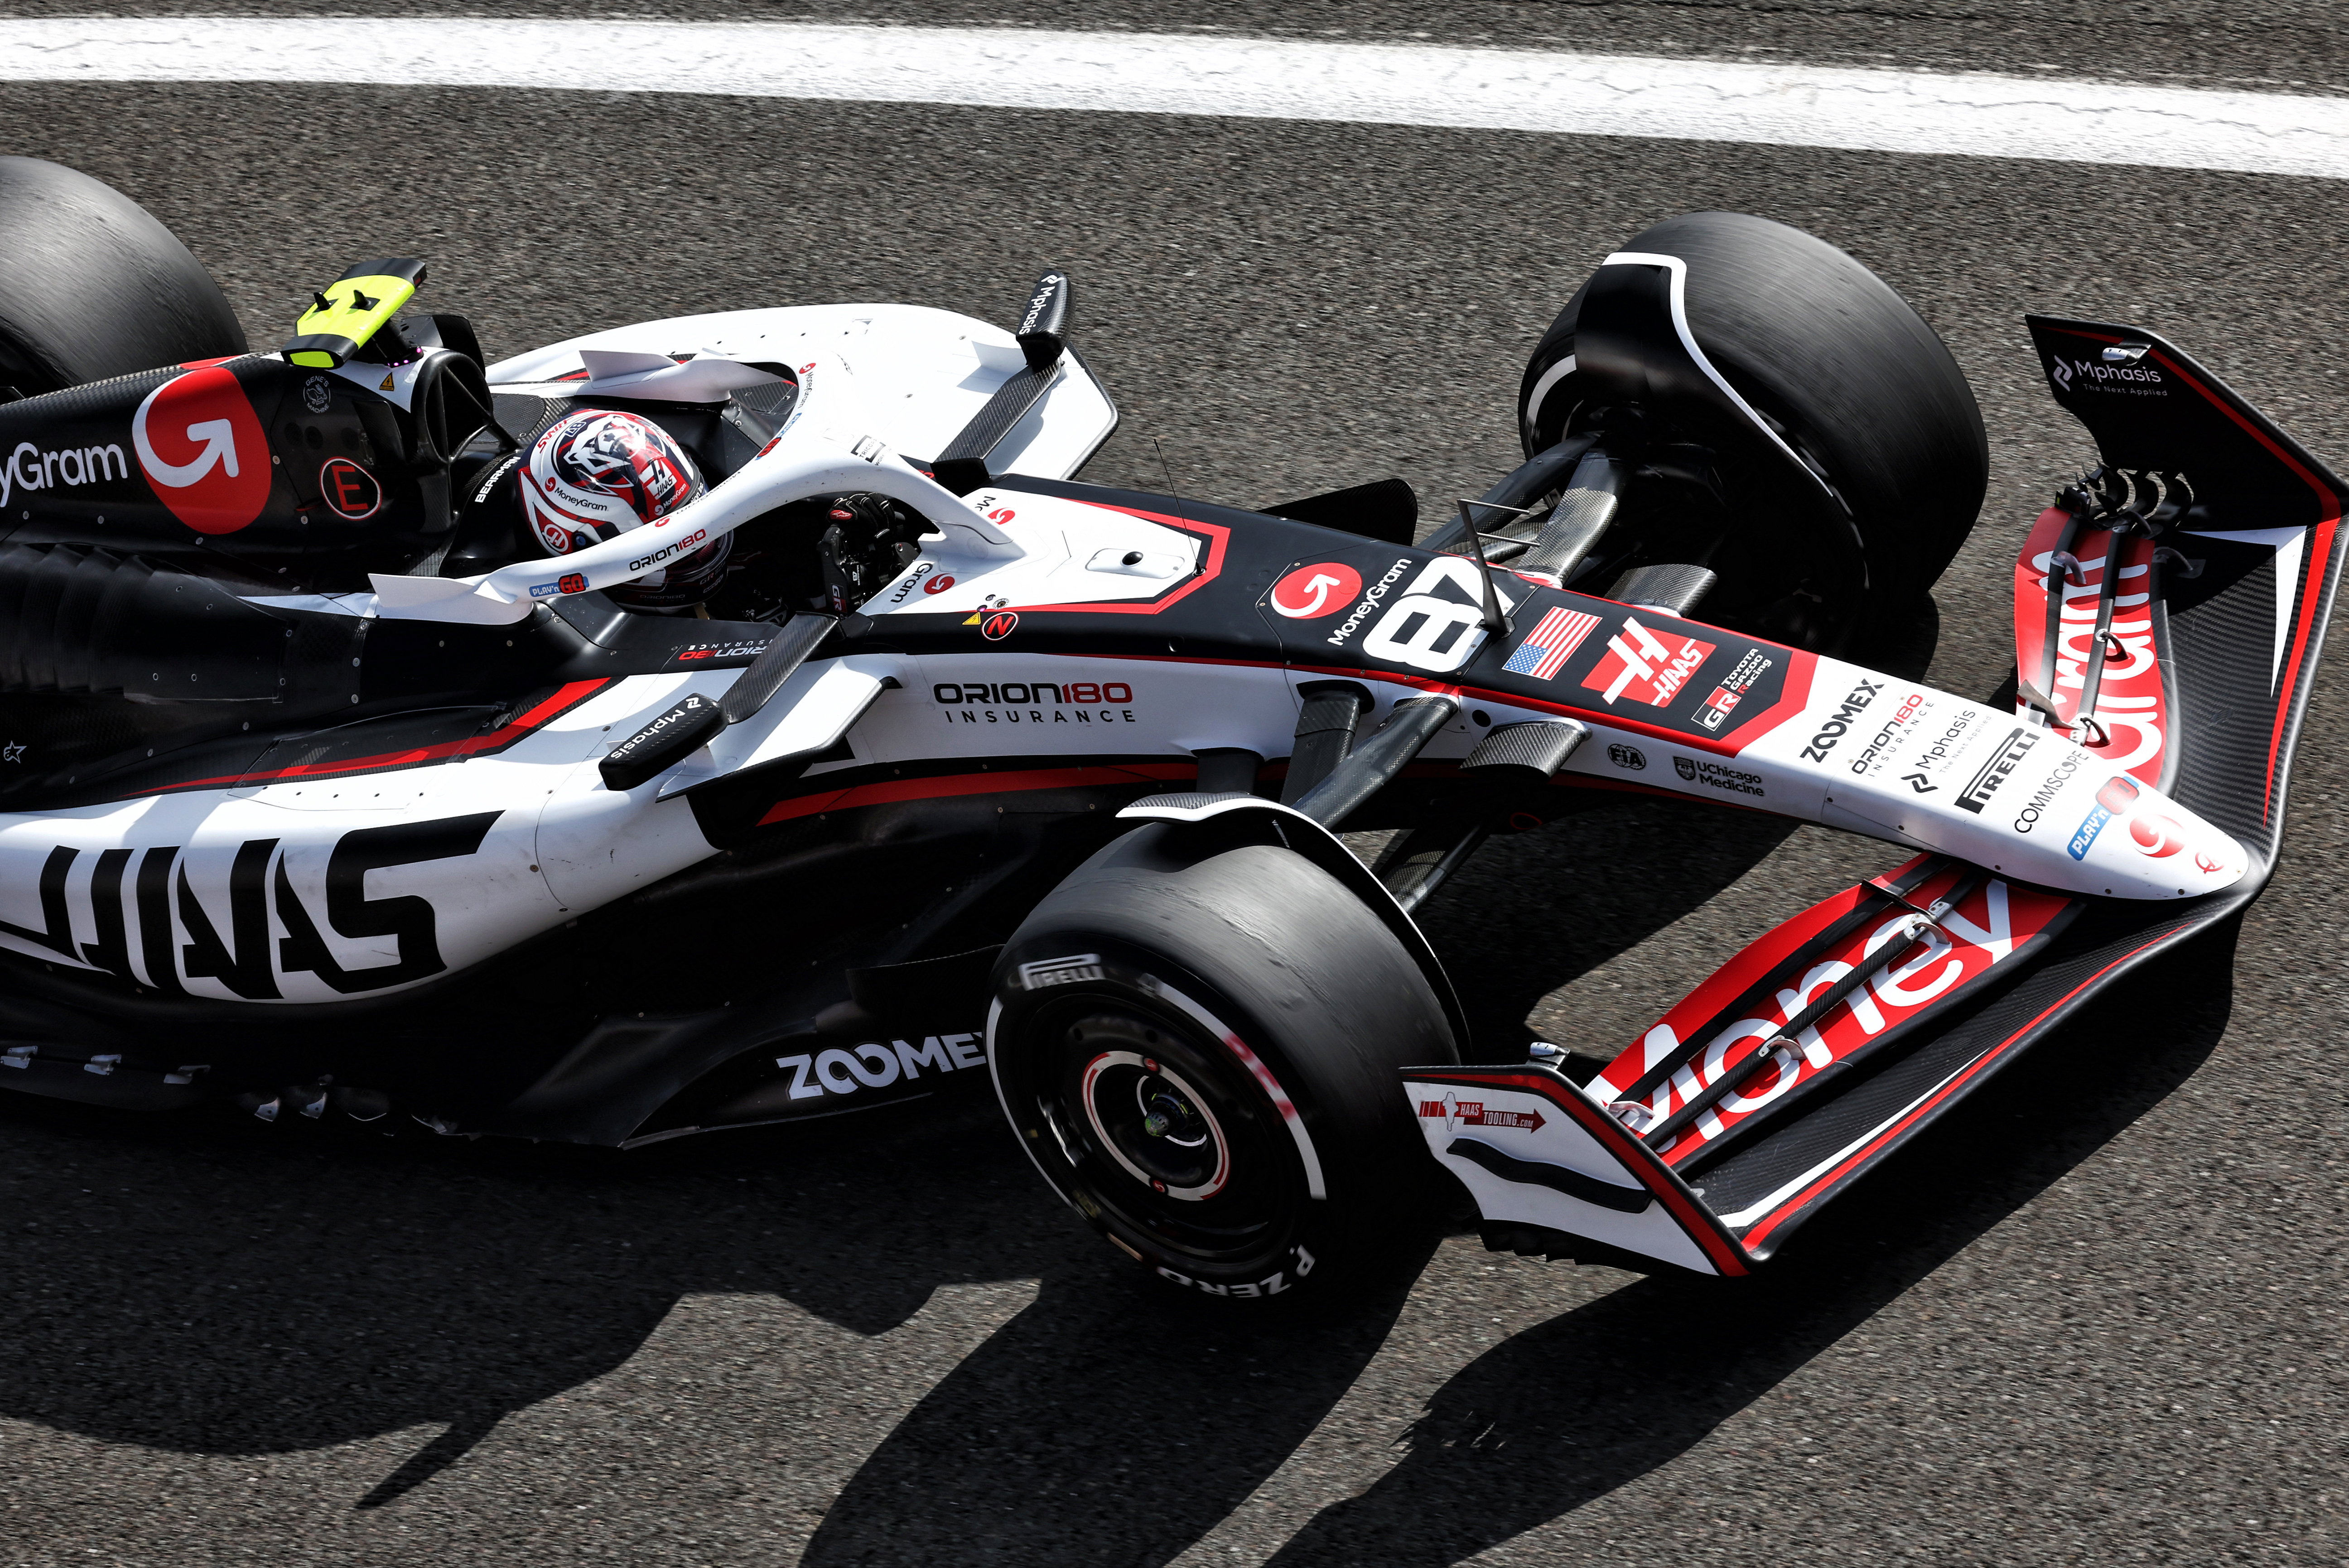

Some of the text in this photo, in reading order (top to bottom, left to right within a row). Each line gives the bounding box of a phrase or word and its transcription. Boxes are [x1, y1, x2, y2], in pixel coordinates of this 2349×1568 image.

[1019, 286, 1053, 335] Mphasis
[305, 376, 329, 387] GENE'S
[2074, 360, 2161, 383] Mphasis
[306, 402, 329, 413] MACHINE
[2104, 386, 2127, 394] Next
[2130, 387, 2168, 397] Applied
[332, 466, 368, 511] E
[475, 456, 521, 503] BEARMAN
[656, 477, 673, 496] HAAS
[663, 483, 686, 508] MoneyGram
[555, 487, 608, 511] MoneyGram
[629, 529, 706, 571] ORION180
[532, 574, 586, 596] PLAY'n GO
[832, 585, 842, 610] GR
[1327, 559, 1411, 646] MoneyGram
[986, 616, 1013, 635] N
[1362, 556, 1515, 672] 87
[679, 646, 767, 660] RION180
[688, 639, 773, 651] SURANCE
[1651, 639, 1703, 705] HAAS
[1721, 648, 1759, 686] TOYOTA
[1730, 654, 1763, 690] GAZOO
[1738, 659, 1772, 694] Racing
[933, 682, 1133, 704] ORION180
[1704, 692, 1739, 728] GR
[611, 709, 685, 759] Mphasis
[945, 709, 1136, 723] INSURANCE
[1799, 679, 1885, 762] ZOOMEX
[1852, 695, 1923, 774] ORION180
[1868, 701, 1934, 777] INSURANCE
[1915, 710, 1976, 769] Mphasis
[1939, 715, 1992, 773] The Next Applied
[1697, 761, 1762, 784] UChicago
[1699, 773, 1765, 797] Medicine
[1953, 728, 2041, 814] PIRELLI
[2014, 750, 2089, 833] COMMSCOPE
[2072, 809, 2109, 855] PLAY'n
[0, 810, 506, 999] HAAS
[1018, 954, 1106, 991] PIRELLI
[776, 1032, 986, 1100] ZOOME
[1460, 1104, 1480, 1116] HAAS
[1157, 1266, 1291, 1298] ZERO
